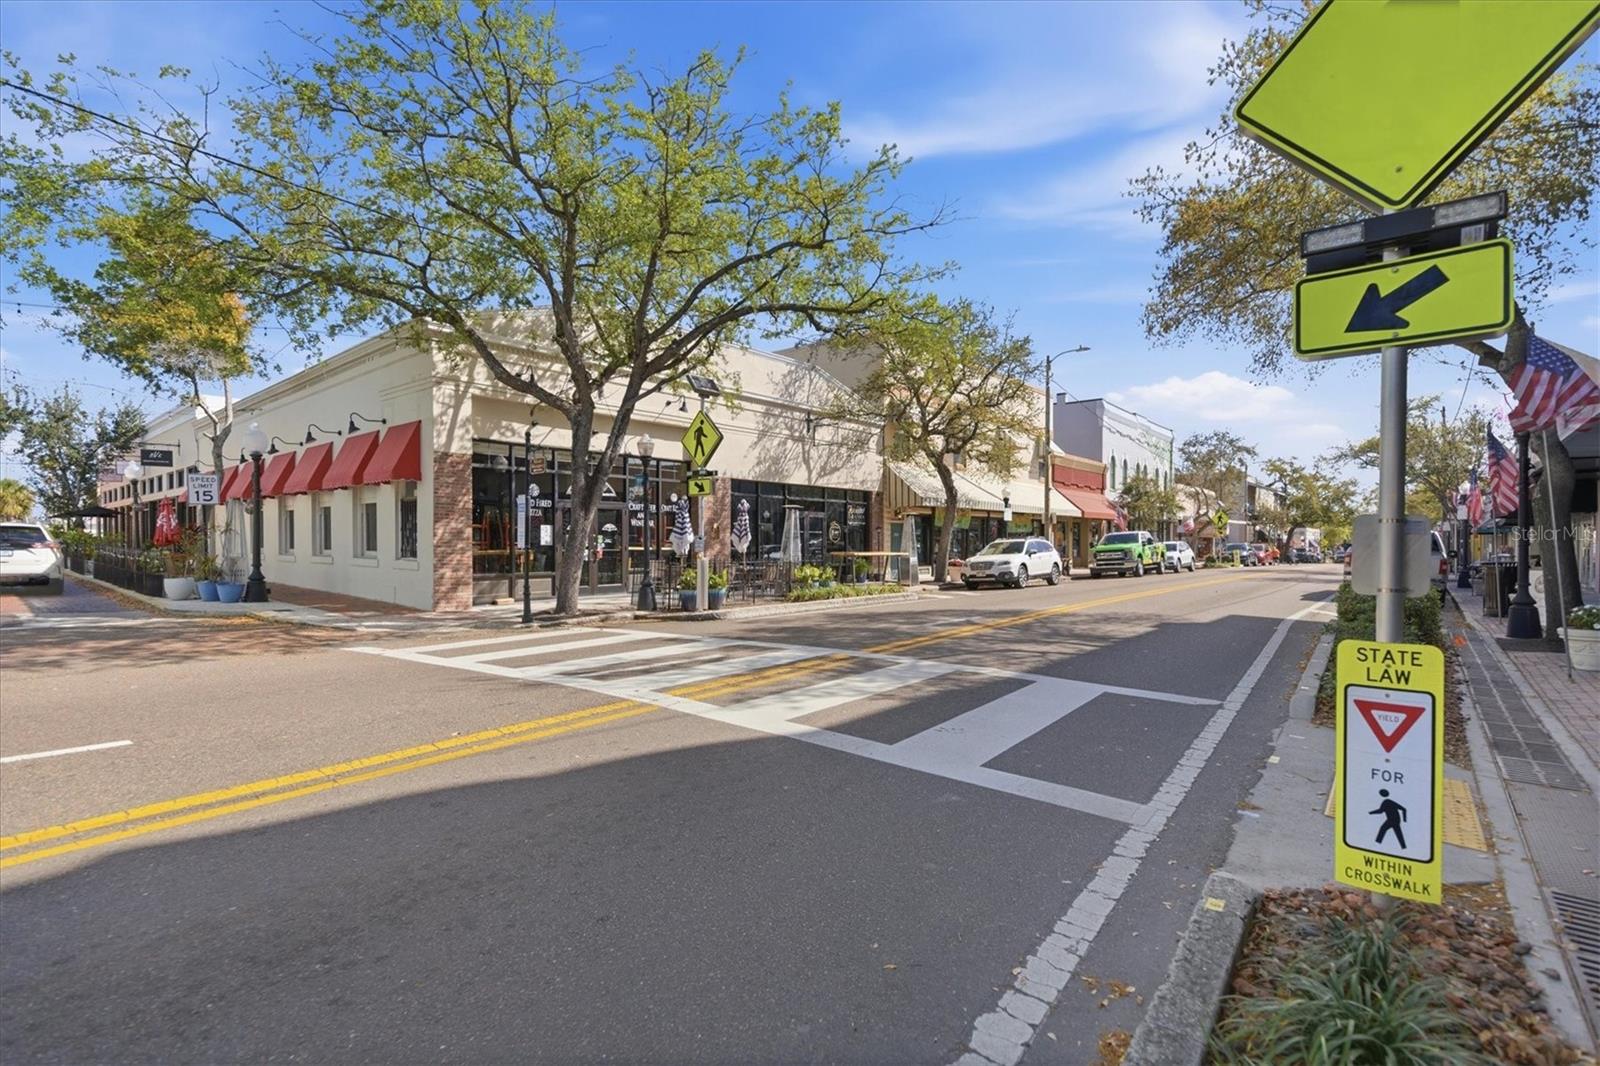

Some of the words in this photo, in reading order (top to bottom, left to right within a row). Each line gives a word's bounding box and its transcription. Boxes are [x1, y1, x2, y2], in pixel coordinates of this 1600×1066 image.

[195, 490, 214, 502] 15
[1356, 647, 1423, 667] STATE
[1366, 667, 1411, 686] LAW
[1378, 714, 1400, 723] YIELD
[1371, 768, 1404, 784] FOR
[1363, 855, 1412, 876] WITHIN
[1345, 866, 1431, 896] CROSSWALK
